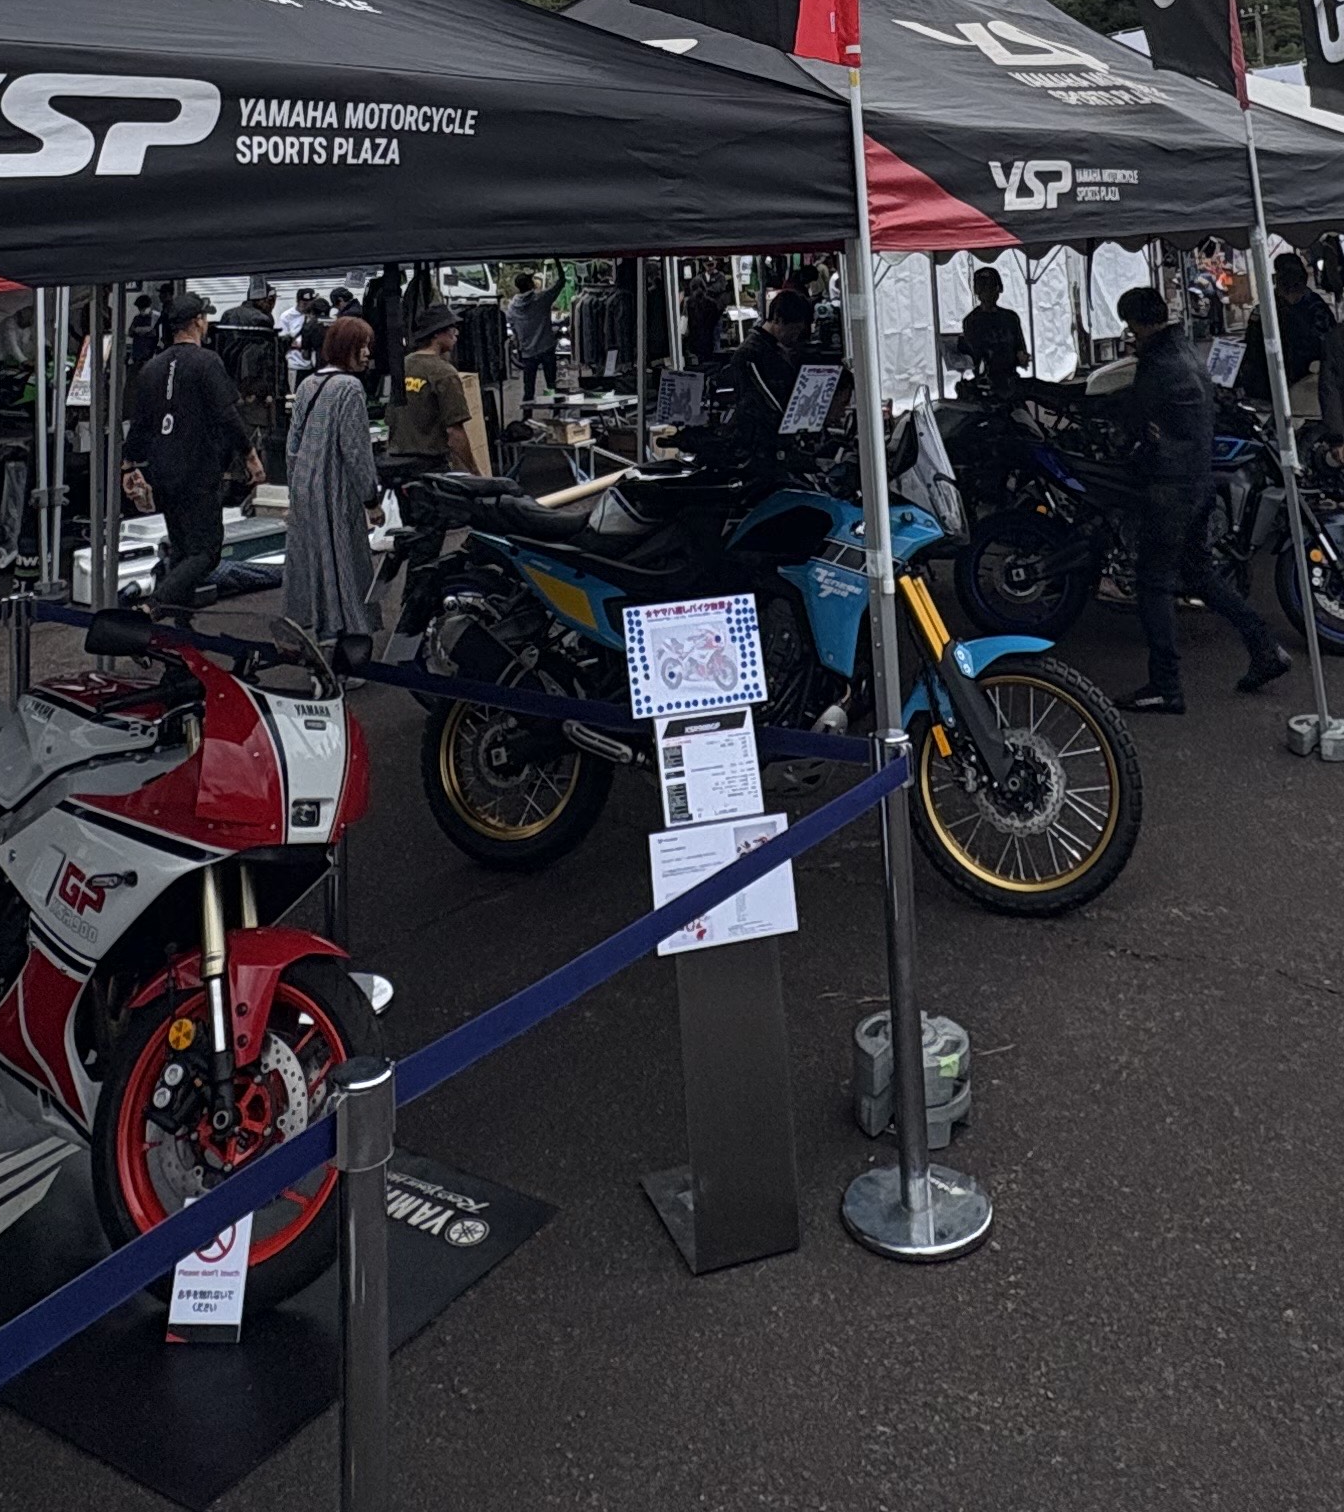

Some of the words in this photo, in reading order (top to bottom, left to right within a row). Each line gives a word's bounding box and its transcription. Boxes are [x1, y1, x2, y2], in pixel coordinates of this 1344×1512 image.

[239, 98, 339, 128] YAMAHA
[345, 102, 479, 135] MOTORCYCLE
[236, 136, 328, 164] SPORTS
[332, 138, 400, 165] PLAZA
[988, 160, 1072, 211] YSP
[294, 704, 331, 718] YAMAHA
[59, 861, 106, 916] GP
